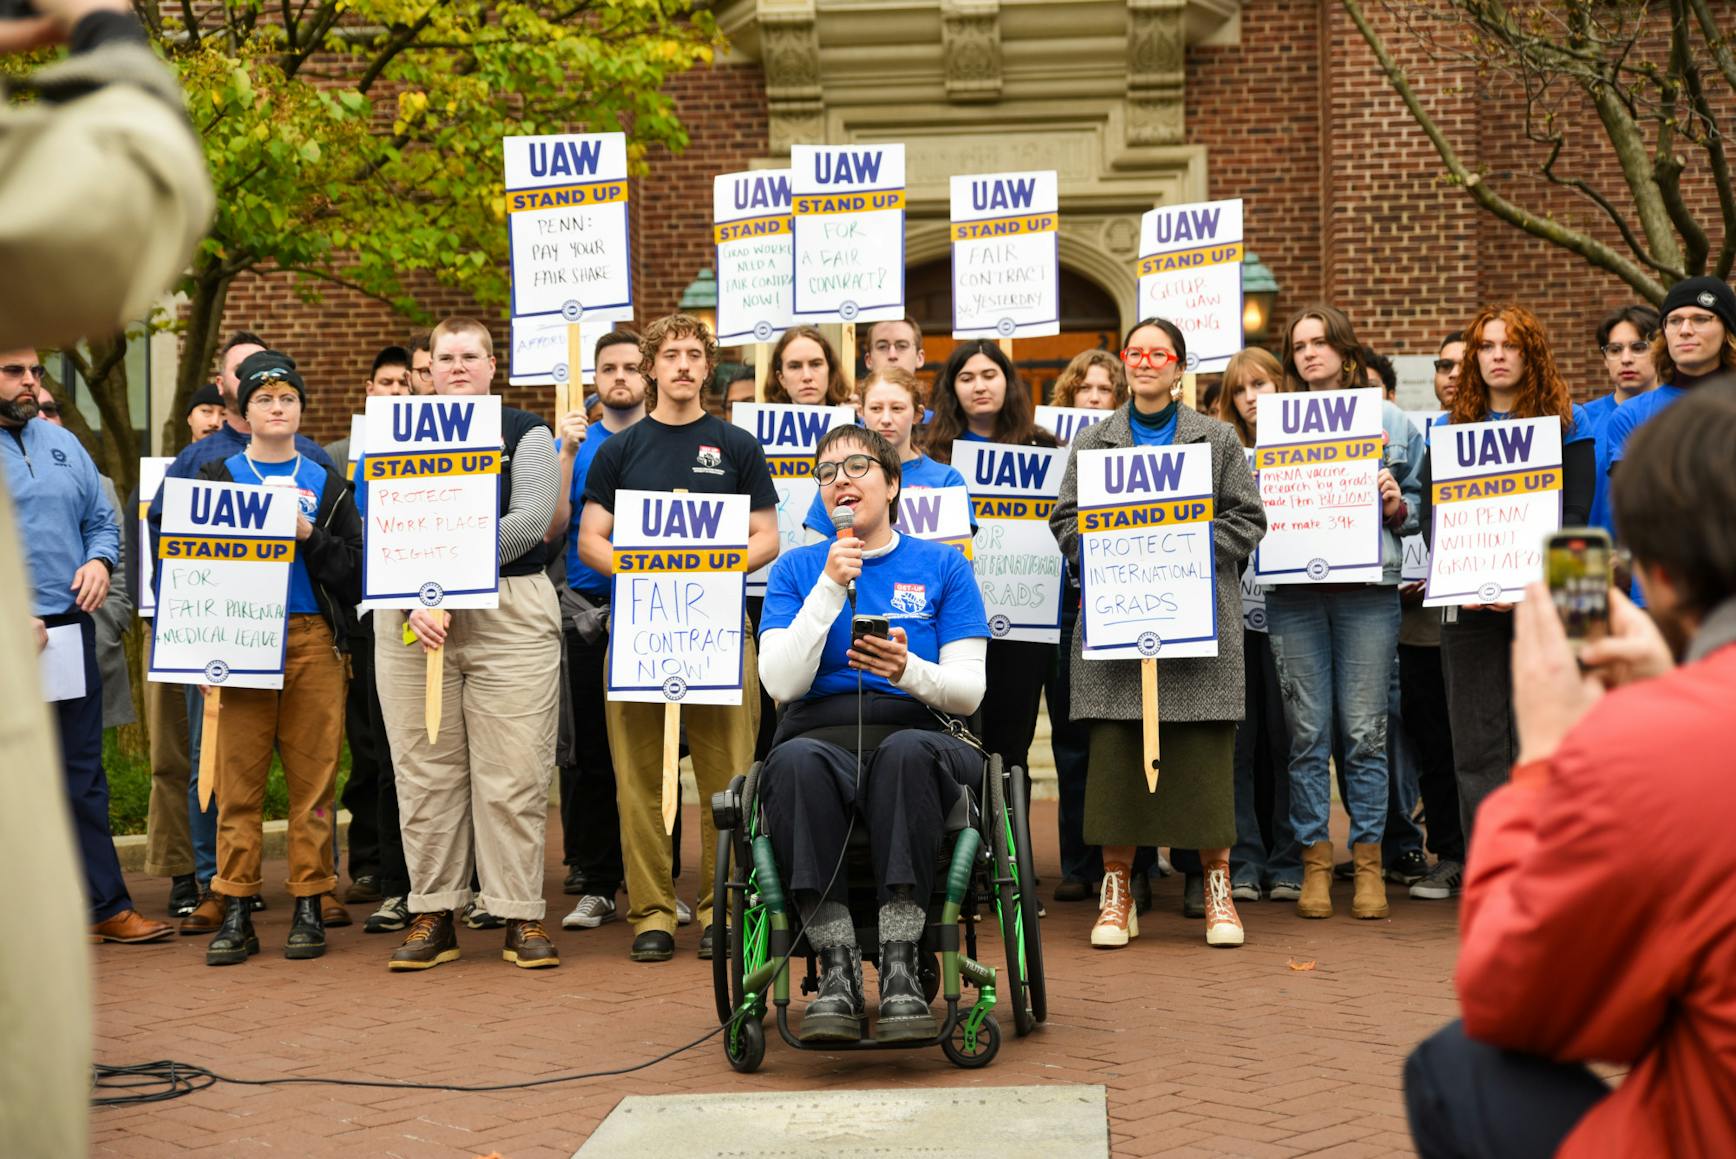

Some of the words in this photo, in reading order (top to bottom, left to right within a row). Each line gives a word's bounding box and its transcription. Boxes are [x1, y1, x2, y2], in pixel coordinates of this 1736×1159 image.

[529, 140, 602, 177] UAW
[815, 151, 882, 184] UAW
[513, 188, 586, 209] STAND
[593, 186, 621, 202] UP
[734, 176, 792, 210] UAW
[798, 197, 866, 213] STAND
[873, 194, 899, 208] UP
[972, 178, 1036, 211] UAW
[537, 215, 592, 235] PENN:
[719, 220, 780, 240] STAND
[824, 221, 866, 239] FOR
[957, 221, 1020, 239] STAND
[1027, 218, 1052, 231] UP
[1157, 208, 1220, 244] UAW
[532, 243, 559, 262] PAY
[569, 239, 605, 258] YOUR
[802, 250, 813, 265] A
[820, 248, 861, 267] FAIR
[969, 244, 1018, 264] FAIR
[1142, 253, 1204, 274] STAND
[1211, 248, 1236, 263] UP
[534, 270, 567, 287] FAIR
[572, 265, 611, 284] SHARE
[737, 259, 765, 273] NEED
[768, 259, 776, 269] A
[960, 266, 1046, 287] CONTRACT
[726, 278, 748, 292] FAIR
[742, 292, 780, 309] NOW!
[972, 291, 1042, 314] YESTERDAY
[1174, 313, 1220, 334] RONG
[393, 403, 474, 442] UAW
[1282, 396, 1357, 434] UAW
[757, 410, 831, 448] UAW
[1263, 446, 1338, 465] STAND
[1345, 443, 1376, 459] UP
[1456, 425, 1535, 468] UAW
[372, 458, 453, 477] STAND
[461, 455, 493, 473] UP
[766, 461, 811, 477] AND
[975, 449, 1052, 489] UAW
[1105, 452, 1185, 494] UAW
[379, 488, 462, 506] PROTECT
[1264, 483, 1310, 496] research
[1317, 479, 1333, 492] by
[1439, 478, 1516, 501] STAND
[1524, 473, 1555, 490] UP
[190, 487, 273, 530] UAW
[642, 498, 724, 539] UAW
[973, 501, 1027, 517] TAND
[1035, 505, 1056, 519] U
[1085, 509, 1165, 529] STAND
[1173, 503, 1206, 520] UP
[1443, 511, 1468, 529] NO
[1476, 503, 1529, 527] PENN
[376, 516, 425, 534] WORK
[436, 514, 489, 532] PLACE
[975, 525, 1004, 549] OR
[1089, 533, 1196, 557] PROTECT
[1441, 530, 1516, 551] WITHOUT
[166, 541, 248, 559] STAND
[256, 544, 288, 559] UP
[382, 545, 459, 565] RIGHTS
[619, 554, 700, 570] STAND
[709, 553, 741, 569] UP
[1090, 562, 1213, 586] INTERNATIONAL
[1438, 554, 1486, 576] GRAD
[1491, 550, 1542, 571] LABO
[172, 568, 218, 590] FOR
[632, 578, 709, 626] FAIR
[982, 580, 1046, 608] RADS
[1096, 592, 1178, 615] GRADS
[169, 598, 217, 619] FAIR
[235, 628, 279, 648] LEAVE
[633, 628, 741, 656] CONTRACT
[637, 655, 710, 682] NOW!
